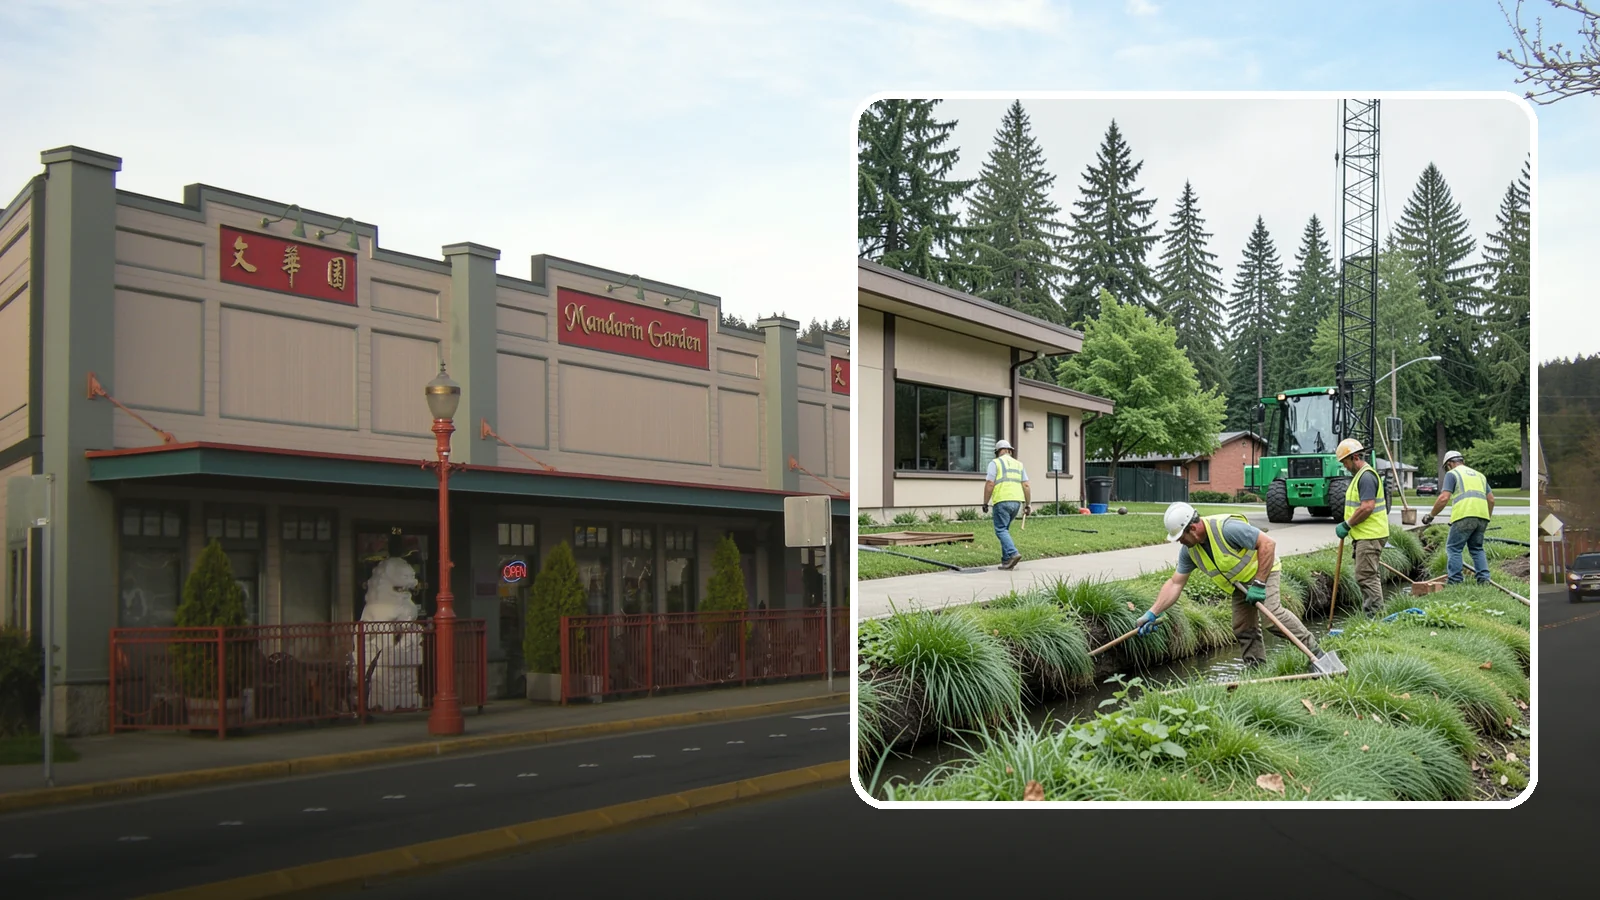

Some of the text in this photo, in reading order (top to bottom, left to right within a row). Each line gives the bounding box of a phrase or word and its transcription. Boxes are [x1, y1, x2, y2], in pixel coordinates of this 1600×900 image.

[231, 236, 346, 291] 文華園
[564, 302, 701, 352] Mandarin Garden
[503, 565, 526, 578] OPEN
